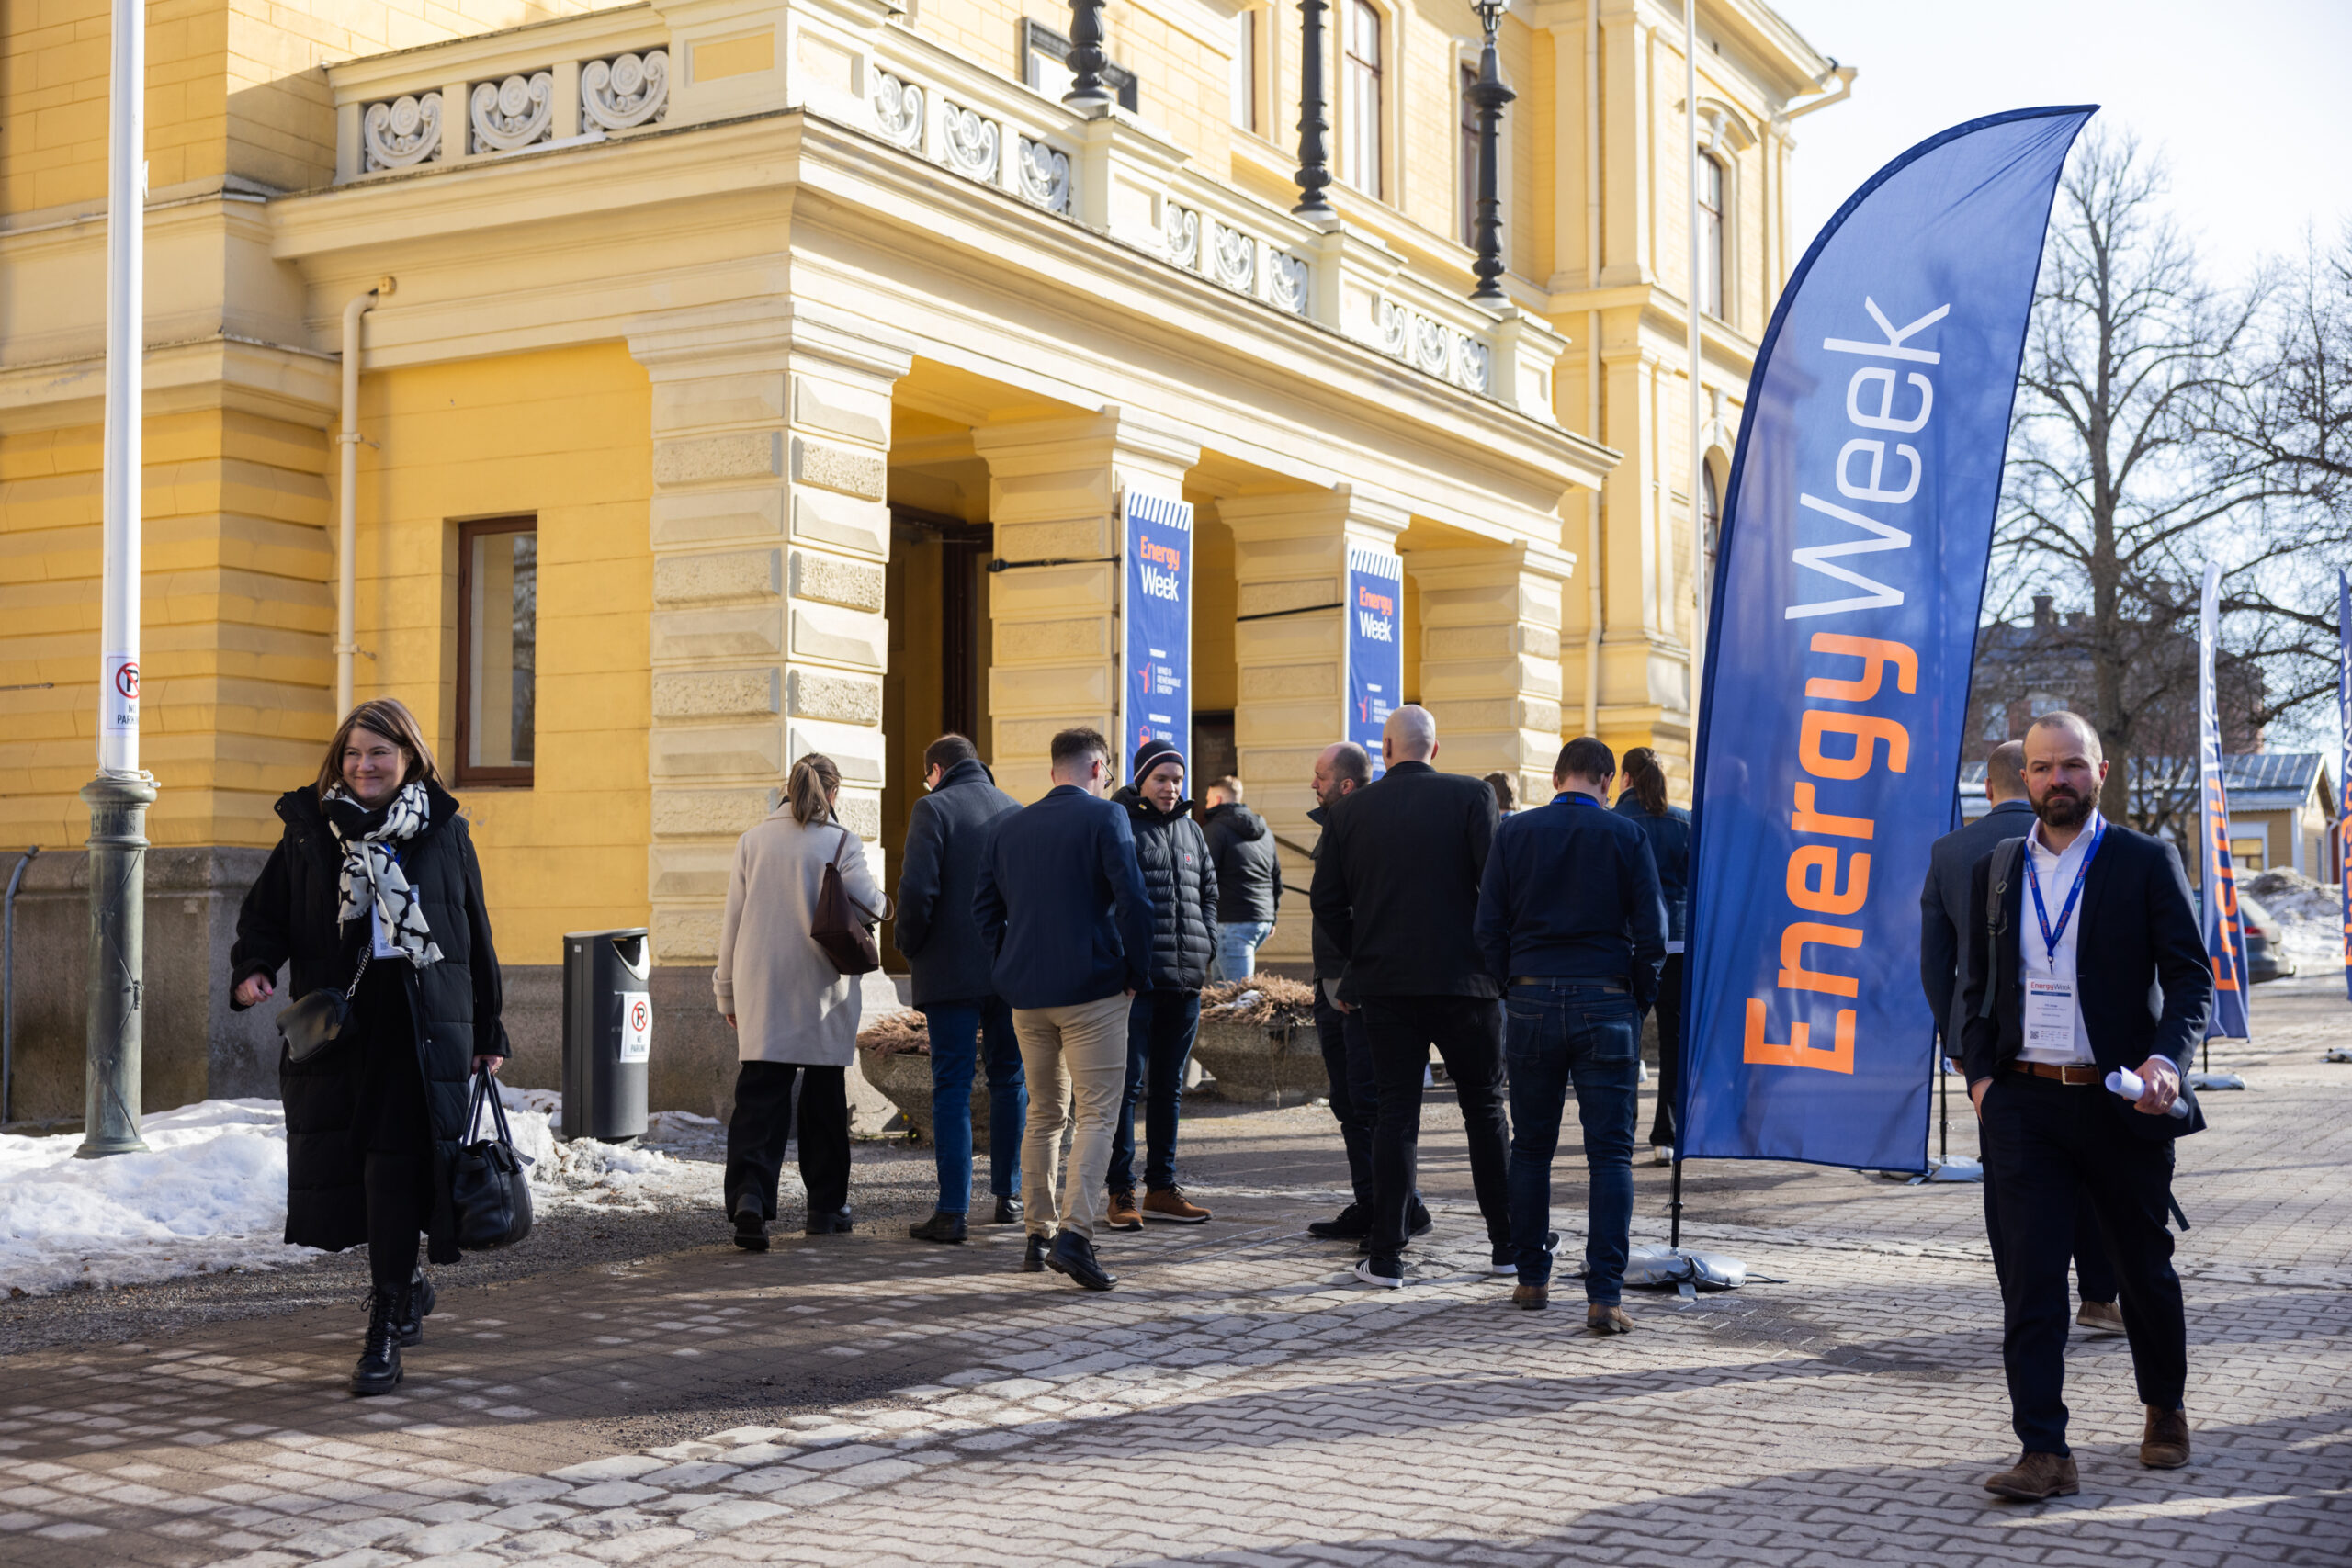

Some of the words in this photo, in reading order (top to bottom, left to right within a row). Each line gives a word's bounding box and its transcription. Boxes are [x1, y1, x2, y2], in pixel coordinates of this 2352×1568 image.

[1140, 536, 1180, 571] Energy
[1140, 563, 1179, 602] Week
[1360, 586, 1393, 616] Energy
[1359, 610, 1392, 643] Week
[1743, 296, 1951, 1075] EnergyWeek
